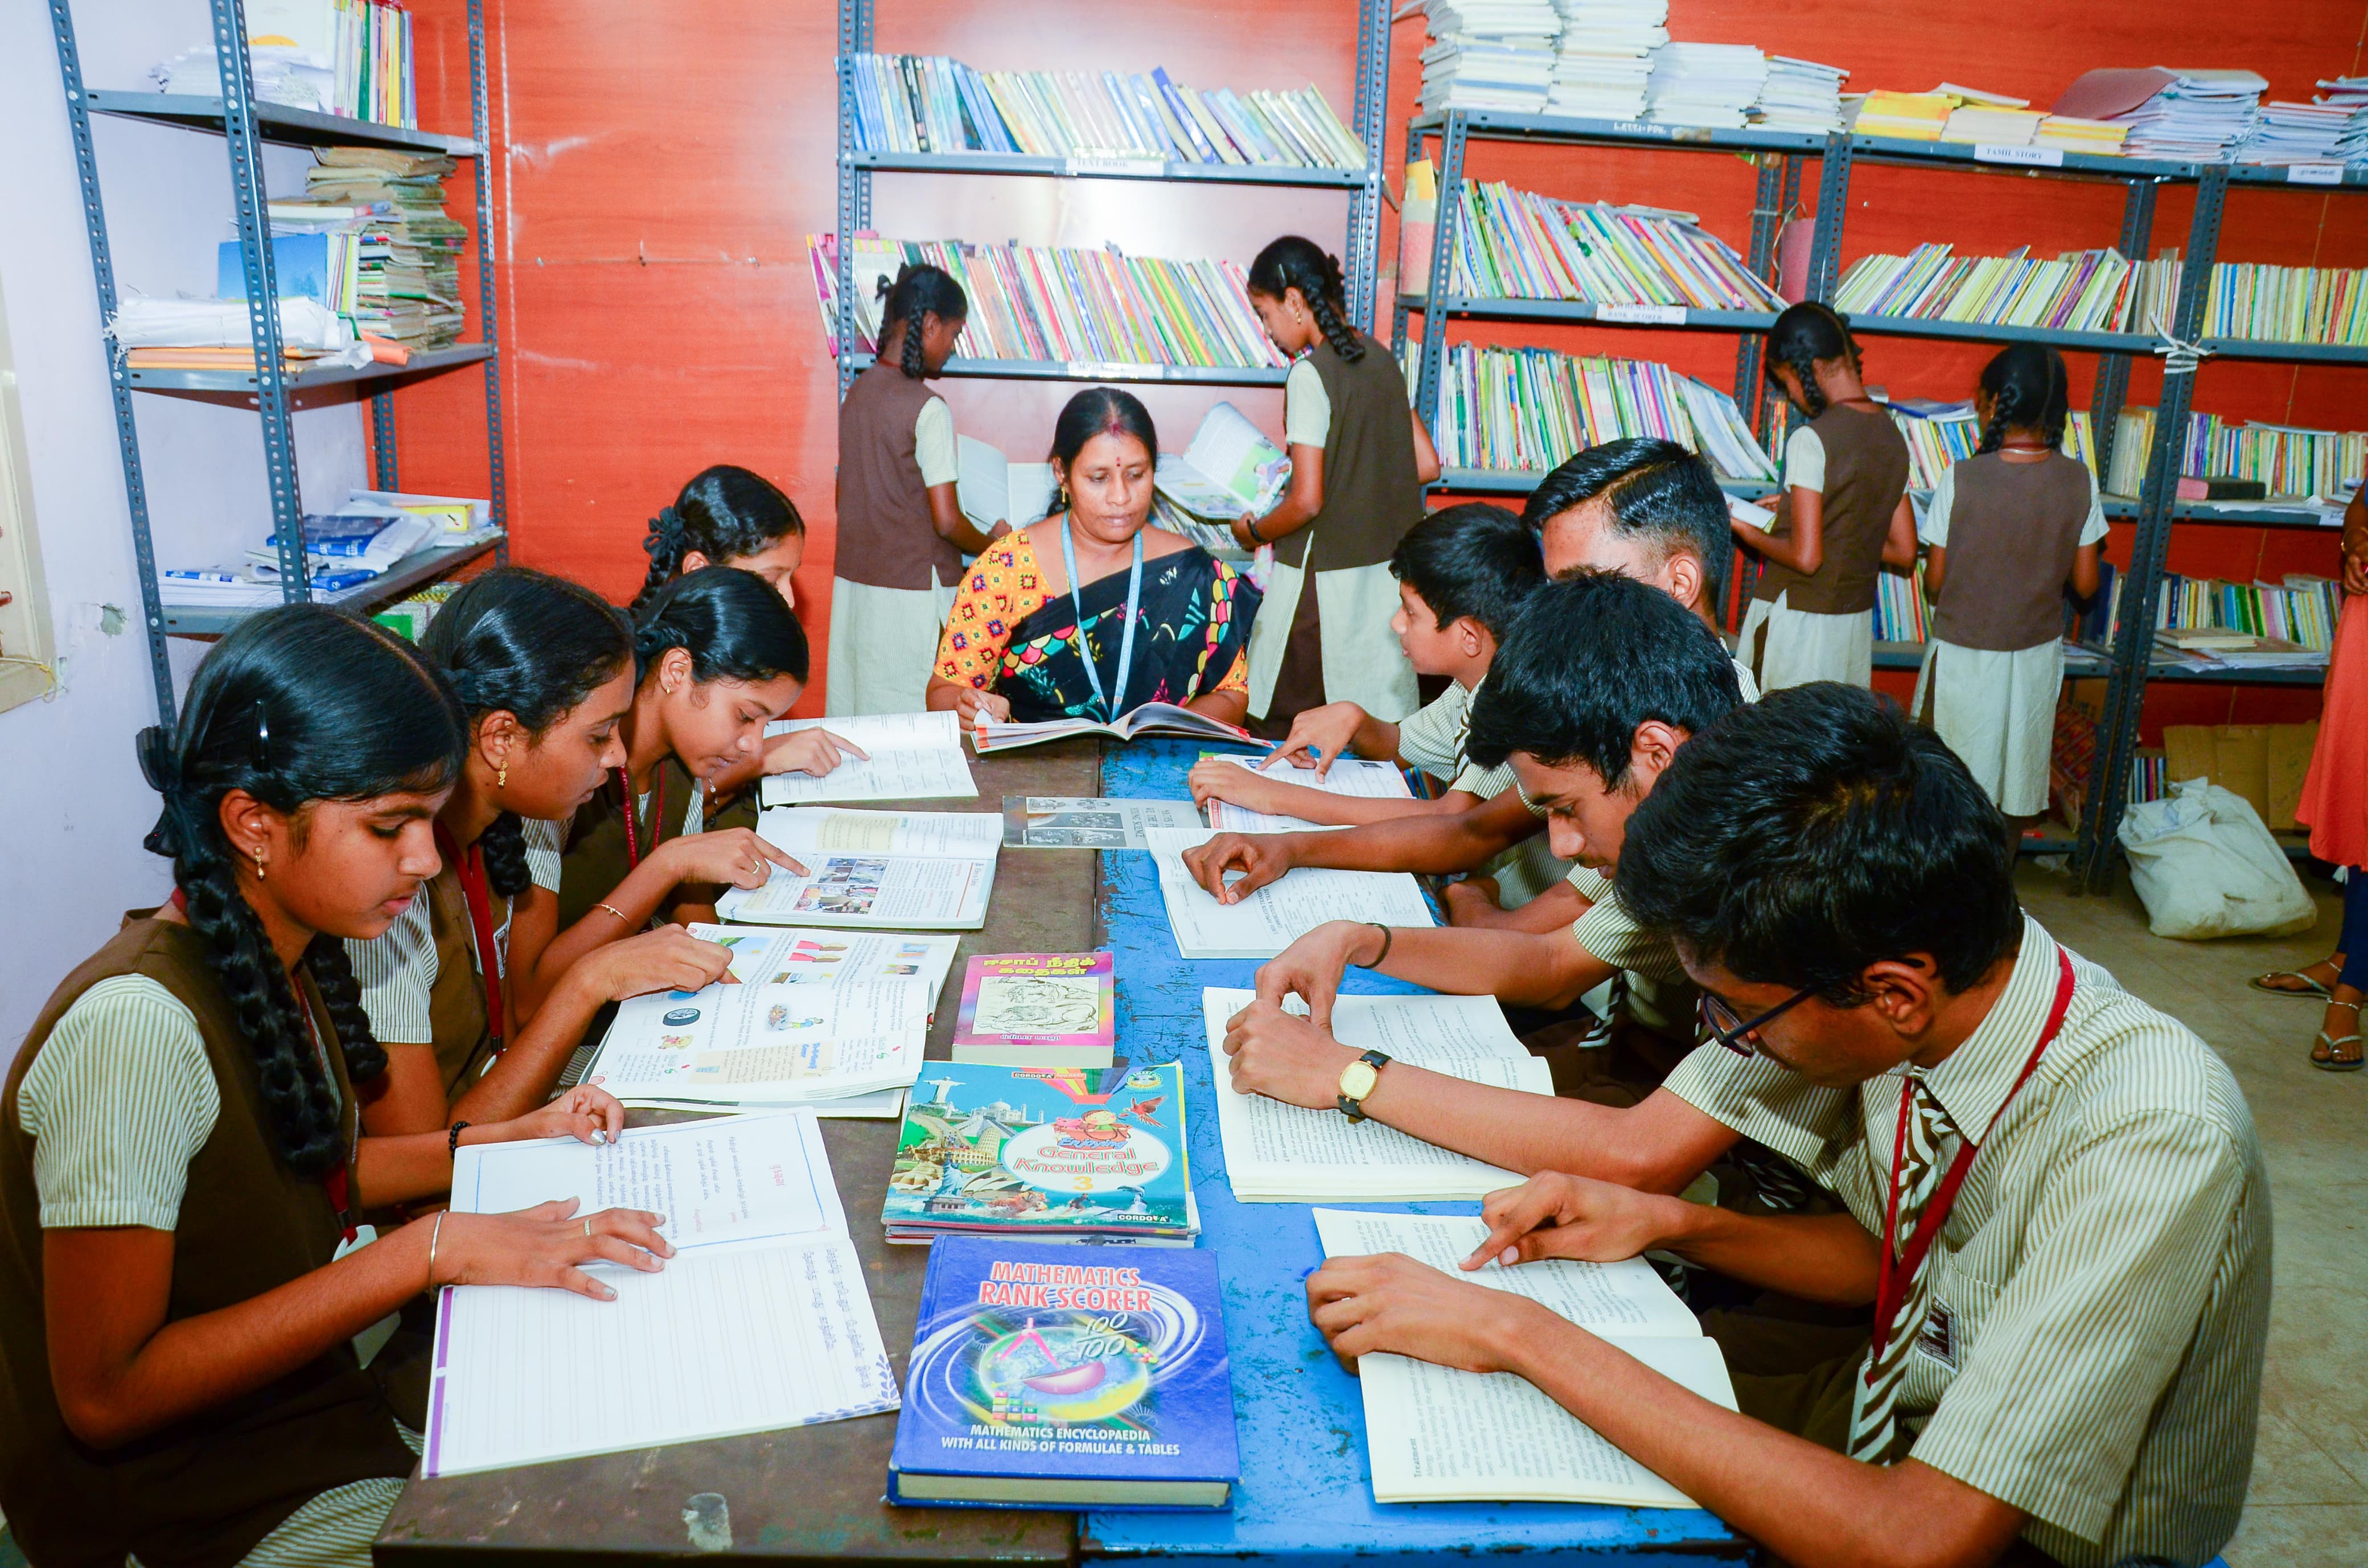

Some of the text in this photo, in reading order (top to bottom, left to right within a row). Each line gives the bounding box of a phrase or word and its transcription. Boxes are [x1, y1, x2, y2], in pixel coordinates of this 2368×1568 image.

[1103, 159, 1129, 167] BOOK
[1987, 148, 2042, 160] TAMIL STORY
[984, 957, 1096, 968] ஈசாப் நீதிக்
[998, 967, 1088, 977] கதைகள்
[1038, 1146, 1136, 1160] General
[1059, 1138, 1128, 1149] Enjoying
[1013, 1157, 1159, 1175] Knowledge
[1073, 1176, 1093, 1191] 3
[991, 1262, 1140, 1287] MATHEMATICS
[980, 1282, 1152, 1311] RANK SCORER
[1079, 1336, 1125, 1359] 100
[1411, 1377, 1422, 1406] performed
[1446, 1380, 1455, 1397] relieve
[1426, 1406, 1439, 1437] identifying
[1453, 1406, 1465, 1437] prescribed
[1486, 1400, 1498, 1427] specialist
[1498, 1401, 1511, 1434] preparation
[1520, 1404, 1531, 1430] injections
[970, 1425, 1150, 1441] MATHEMATICS ENCYCLOPAEDIA
[1548, 1417, 1557, 1438] allergic
[942, 1437, 1179, 1455] WITH ALL KINDS OF FORMULAE & TABLES
[1478, 1427, 1489, 1450] treating
[1409, 1438, 1422, 1477] Treatment
[1461, 1451, 1470, 1468] Drugs
[1519, 1443, 1530, 1462] person
[1542, 1448, 1553, 1477] resistance
[1557, 1452, 1566, 1463] you
[1575, 1438, 1589, 1467] particular
[1588, 1452, 1598, 1473] identify
[1474, 1456, 1483, 1476] severe
[1486, 1461, 1495, 1476] used
[1532, 1452, 1543, 1477] strength
[1568, 1457, 1579, 1479] identify
